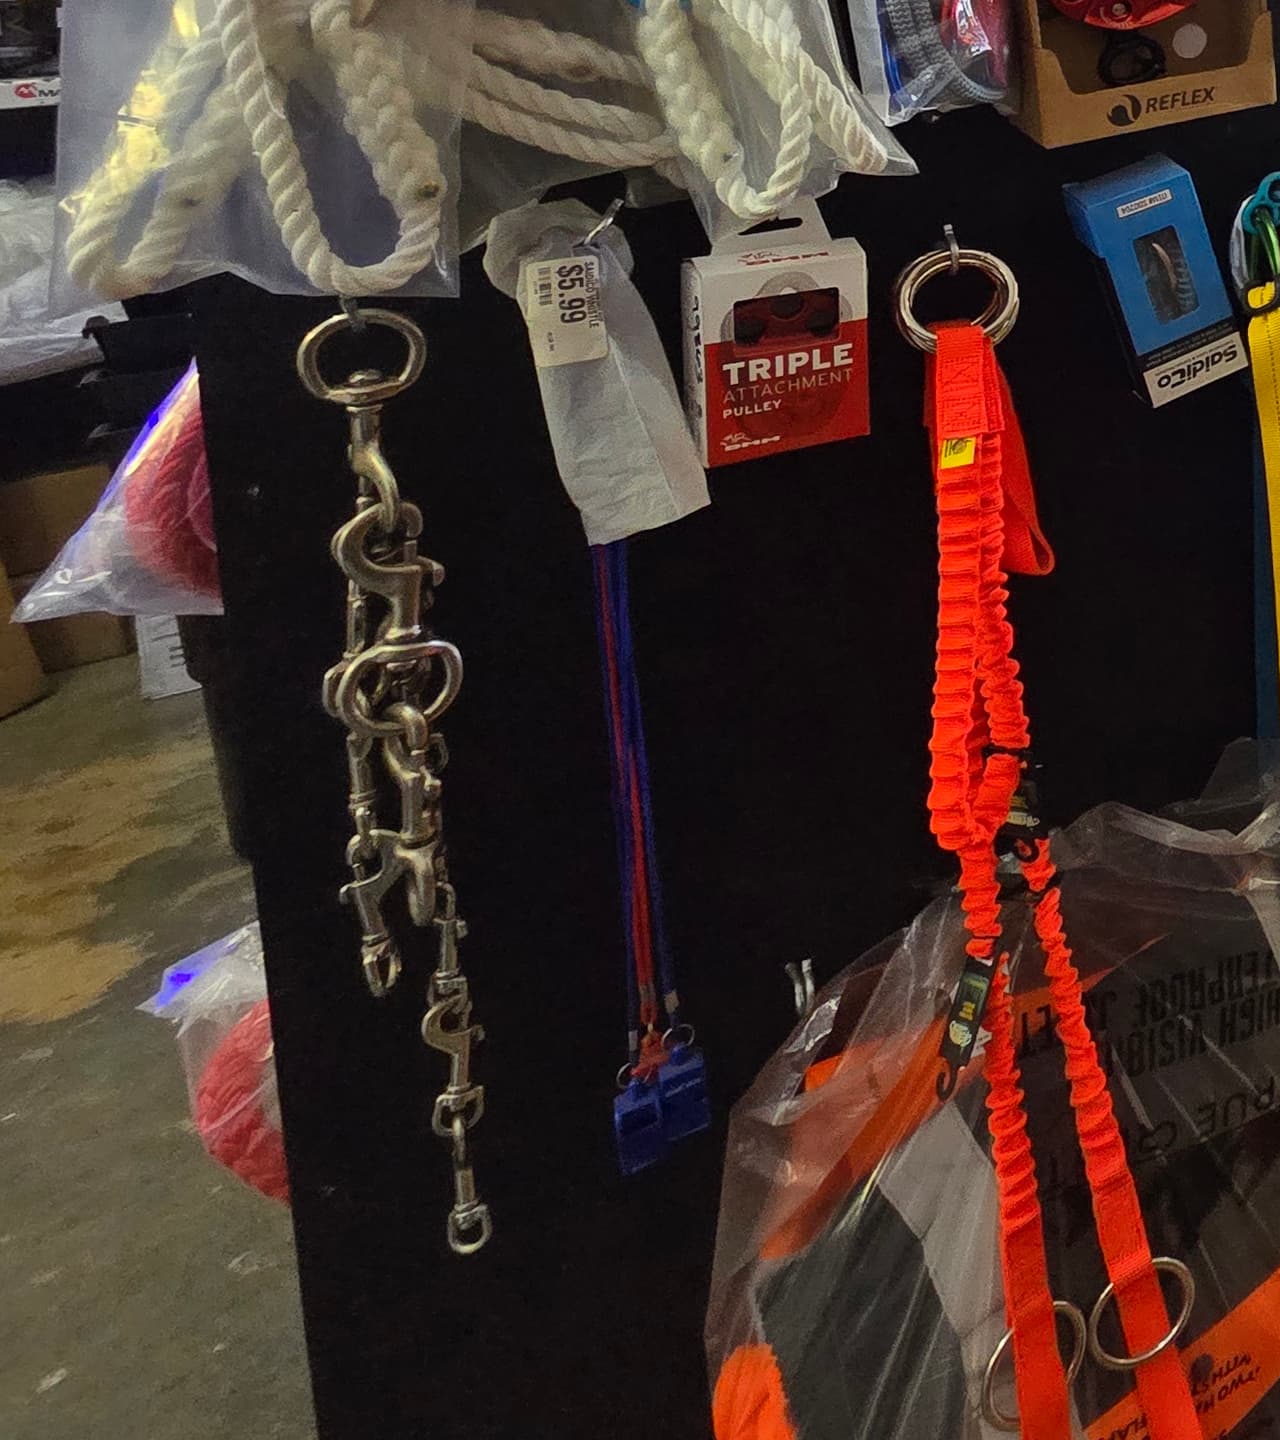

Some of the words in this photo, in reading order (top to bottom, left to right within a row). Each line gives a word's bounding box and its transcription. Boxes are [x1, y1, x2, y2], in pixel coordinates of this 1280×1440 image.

[1144, 86, 1216, 114] REFLEX
[555, 263, 587, 324] $5.99
[722, 343, 853, 386] TRIPLE
[723, 368, 853, 404] ATTACHMENT
[723, 399, 782, 419] PULLEY
